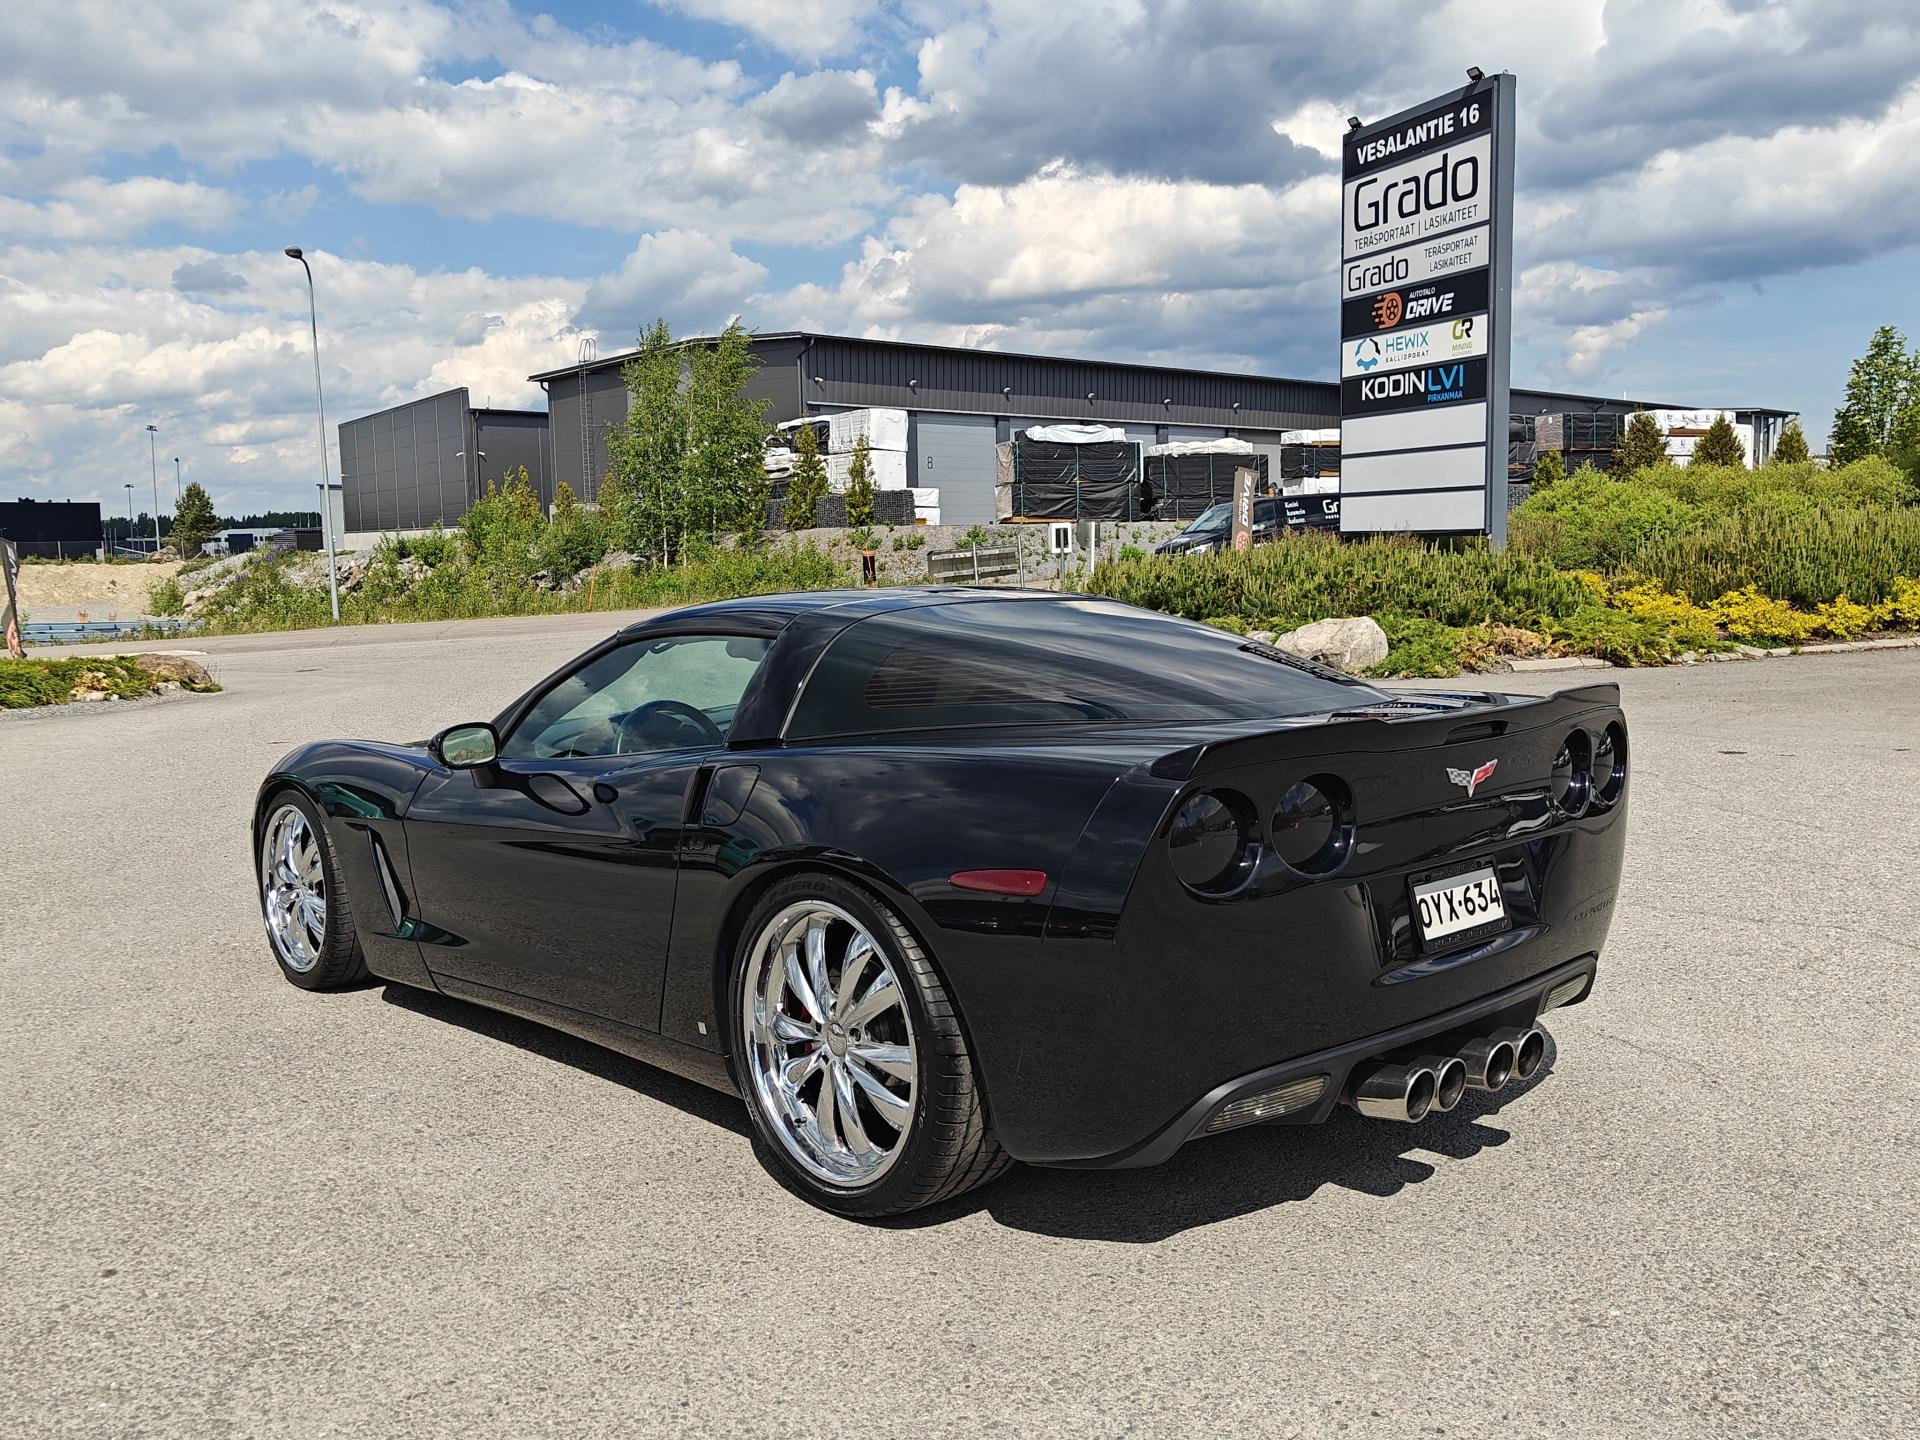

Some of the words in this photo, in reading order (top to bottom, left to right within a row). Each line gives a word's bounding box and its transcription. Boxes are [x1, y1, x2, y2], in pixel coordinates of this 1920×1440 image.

[1357, 113, 1454, 164] VESALANTIE
[1459, 103, 1480, 127] 16
[1354, 153, 1479, 232] Grado
[1354, 222, 1416, 251] TERÄSPORTAAT
[1424, 204, 1478, 231] LASIKAITEET
[1424, 235, 1478, 258] TERÄSPORTAAT
[1348, 255, 1409, 292] Grado
[1429, 252, 1473, 272] LASIKAITEET
[1408, 286, 1436, 299] AUTOTALO
[1405, 292, 1454, 320] DRIVE
[1385, 331, 1429, 353] HEWIX
[1452, 341, 1473, 352] MINING
[1385, 350, 1429, 363] KALLIOPORAT
[1427, 390, 1463, 403] PIRKANMAA
[927, 456, 933, 470] 8
[1242, 472, 1252, 528] DRIVE
[1418, 879, 1501, 928] OYX-634
